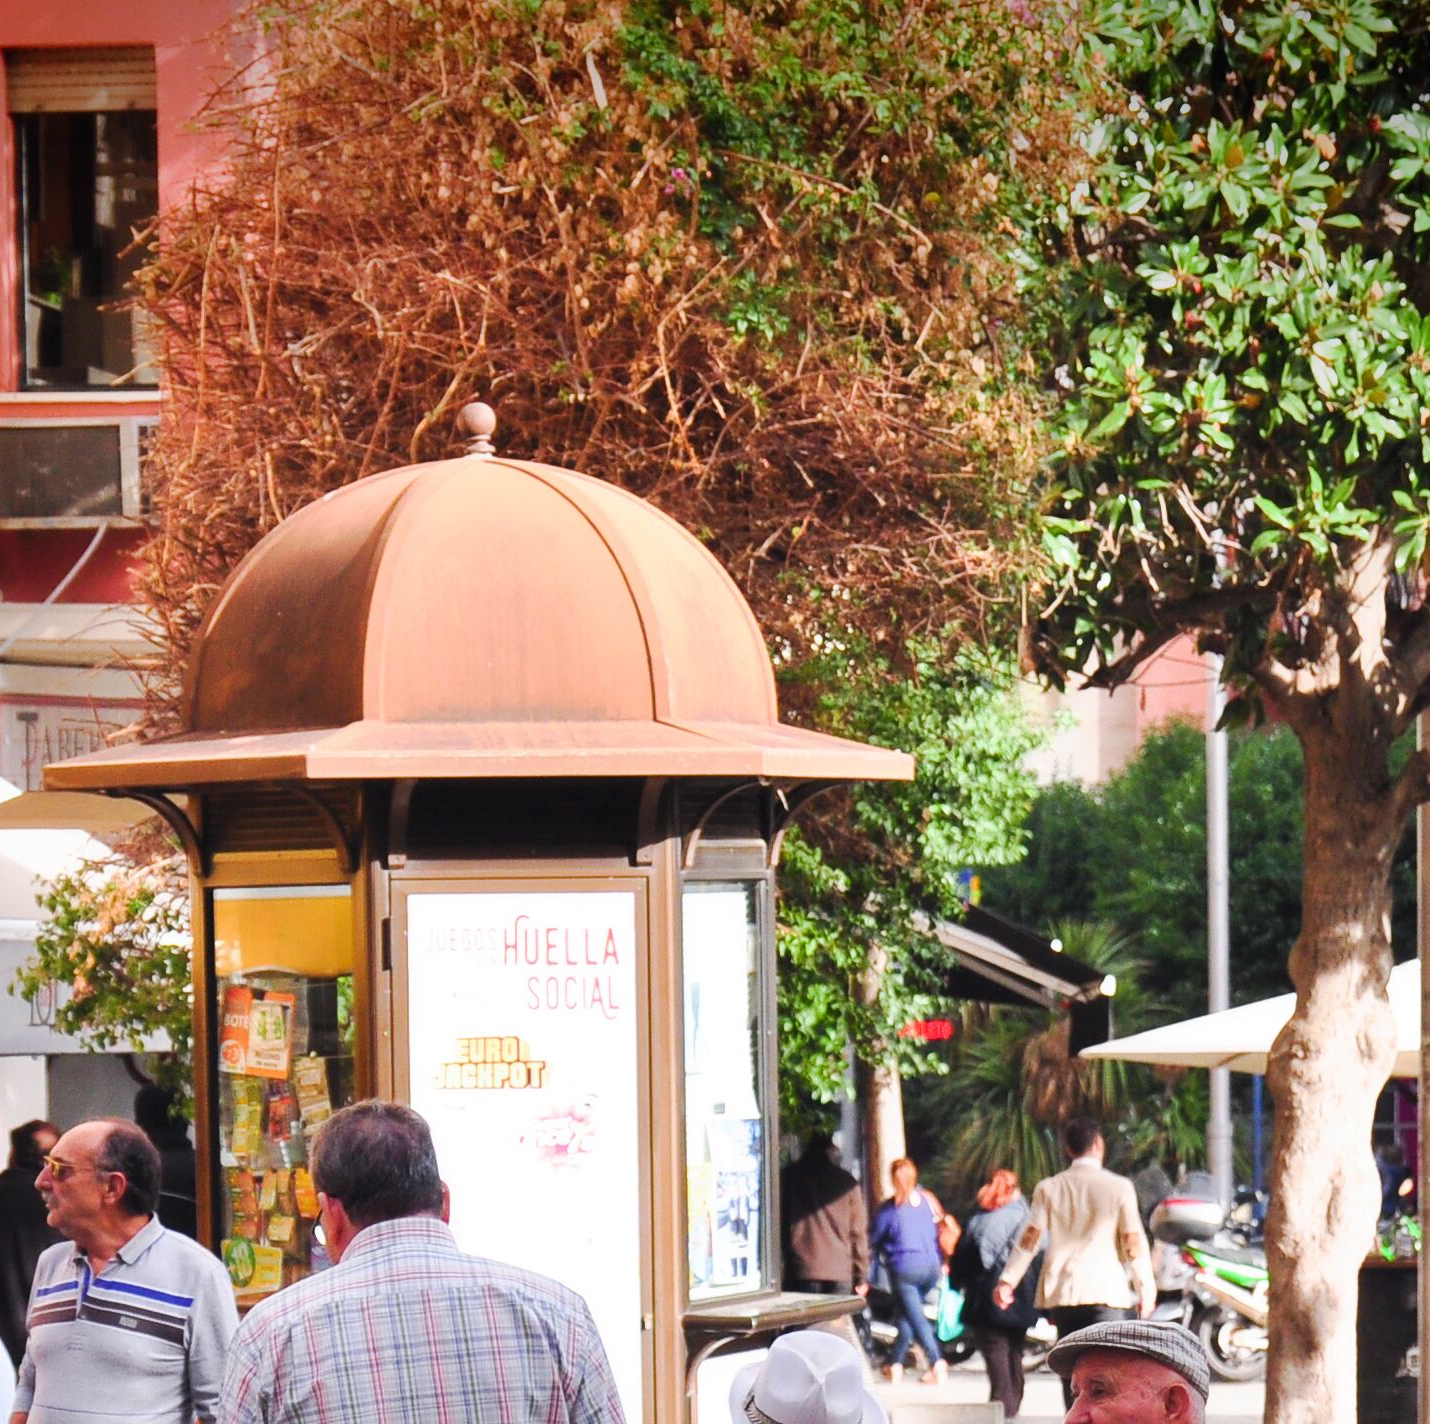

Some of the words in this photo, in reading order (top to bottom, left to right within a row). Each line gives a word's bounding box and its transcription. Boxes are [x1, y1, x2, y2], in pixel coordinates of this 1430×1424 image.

[426, 927, 497, 952] JUEGOS
[503, 915, 620, 967] HUELLA
[527, 975, 620, 1020] SOCIAL
[456, 1036, 521, 1063] EURO
